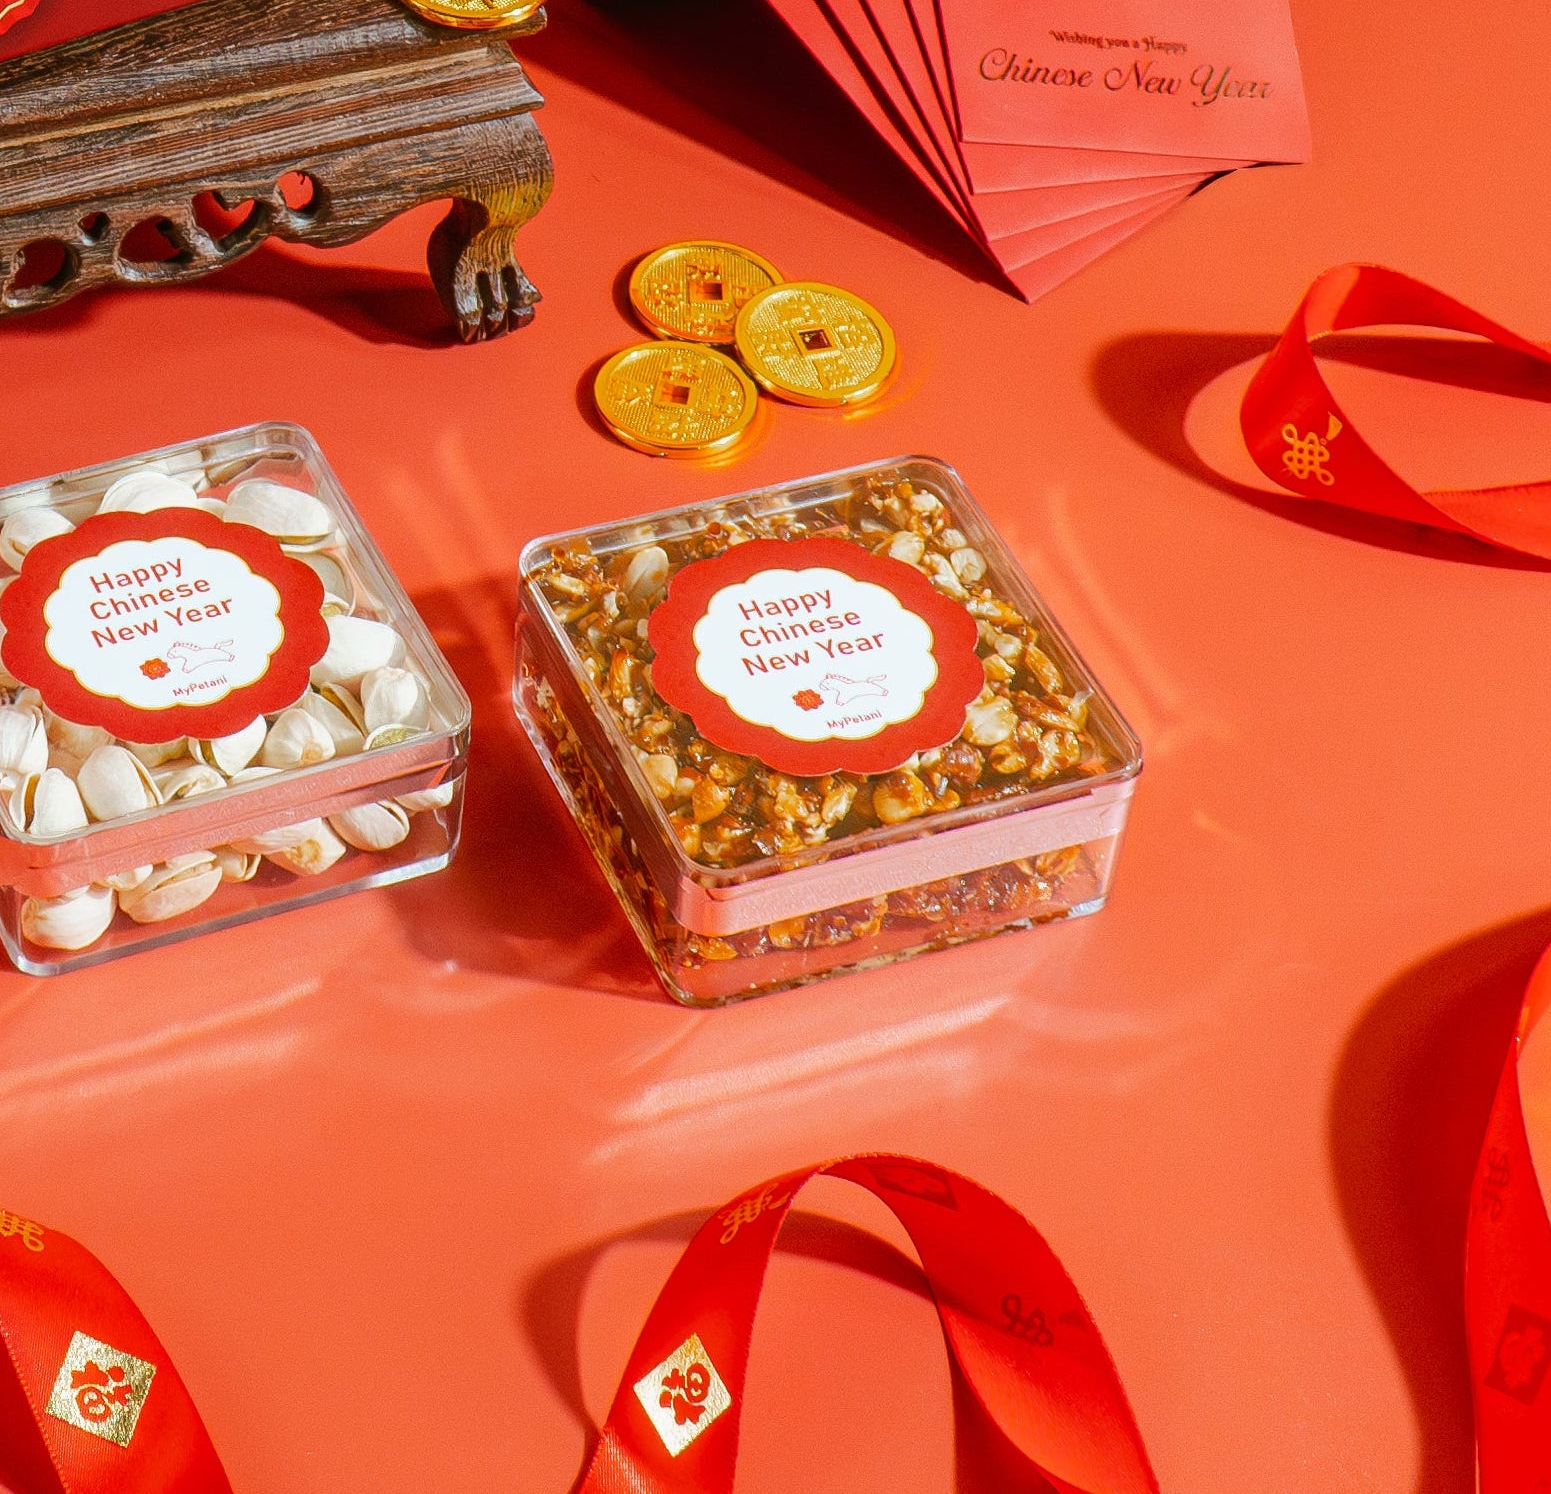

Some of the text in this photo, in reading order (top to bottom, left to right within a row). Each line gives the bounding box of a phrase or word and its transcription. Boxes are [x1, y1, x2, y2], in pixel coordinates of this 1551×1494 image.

[1048, 28, 1104, 49] Wishing
[1105, 37, 1130, 50] you
[1131, 39, 1141, 49] a
[979, 47, 1274, 108] Chinese New Year
[88, 557, 183, 594] Happy
[89, 578, 211, 620] Chinese
[737, 588, 833, 622] Happy
[90, 596, 234, 649] New Year
[739, 609, 862, 648] Chinese
[741, 631, 885, 677] New Year
[171, 674, 228, 698] MyPetani
[826, 709, 883, 731] MyPetani
